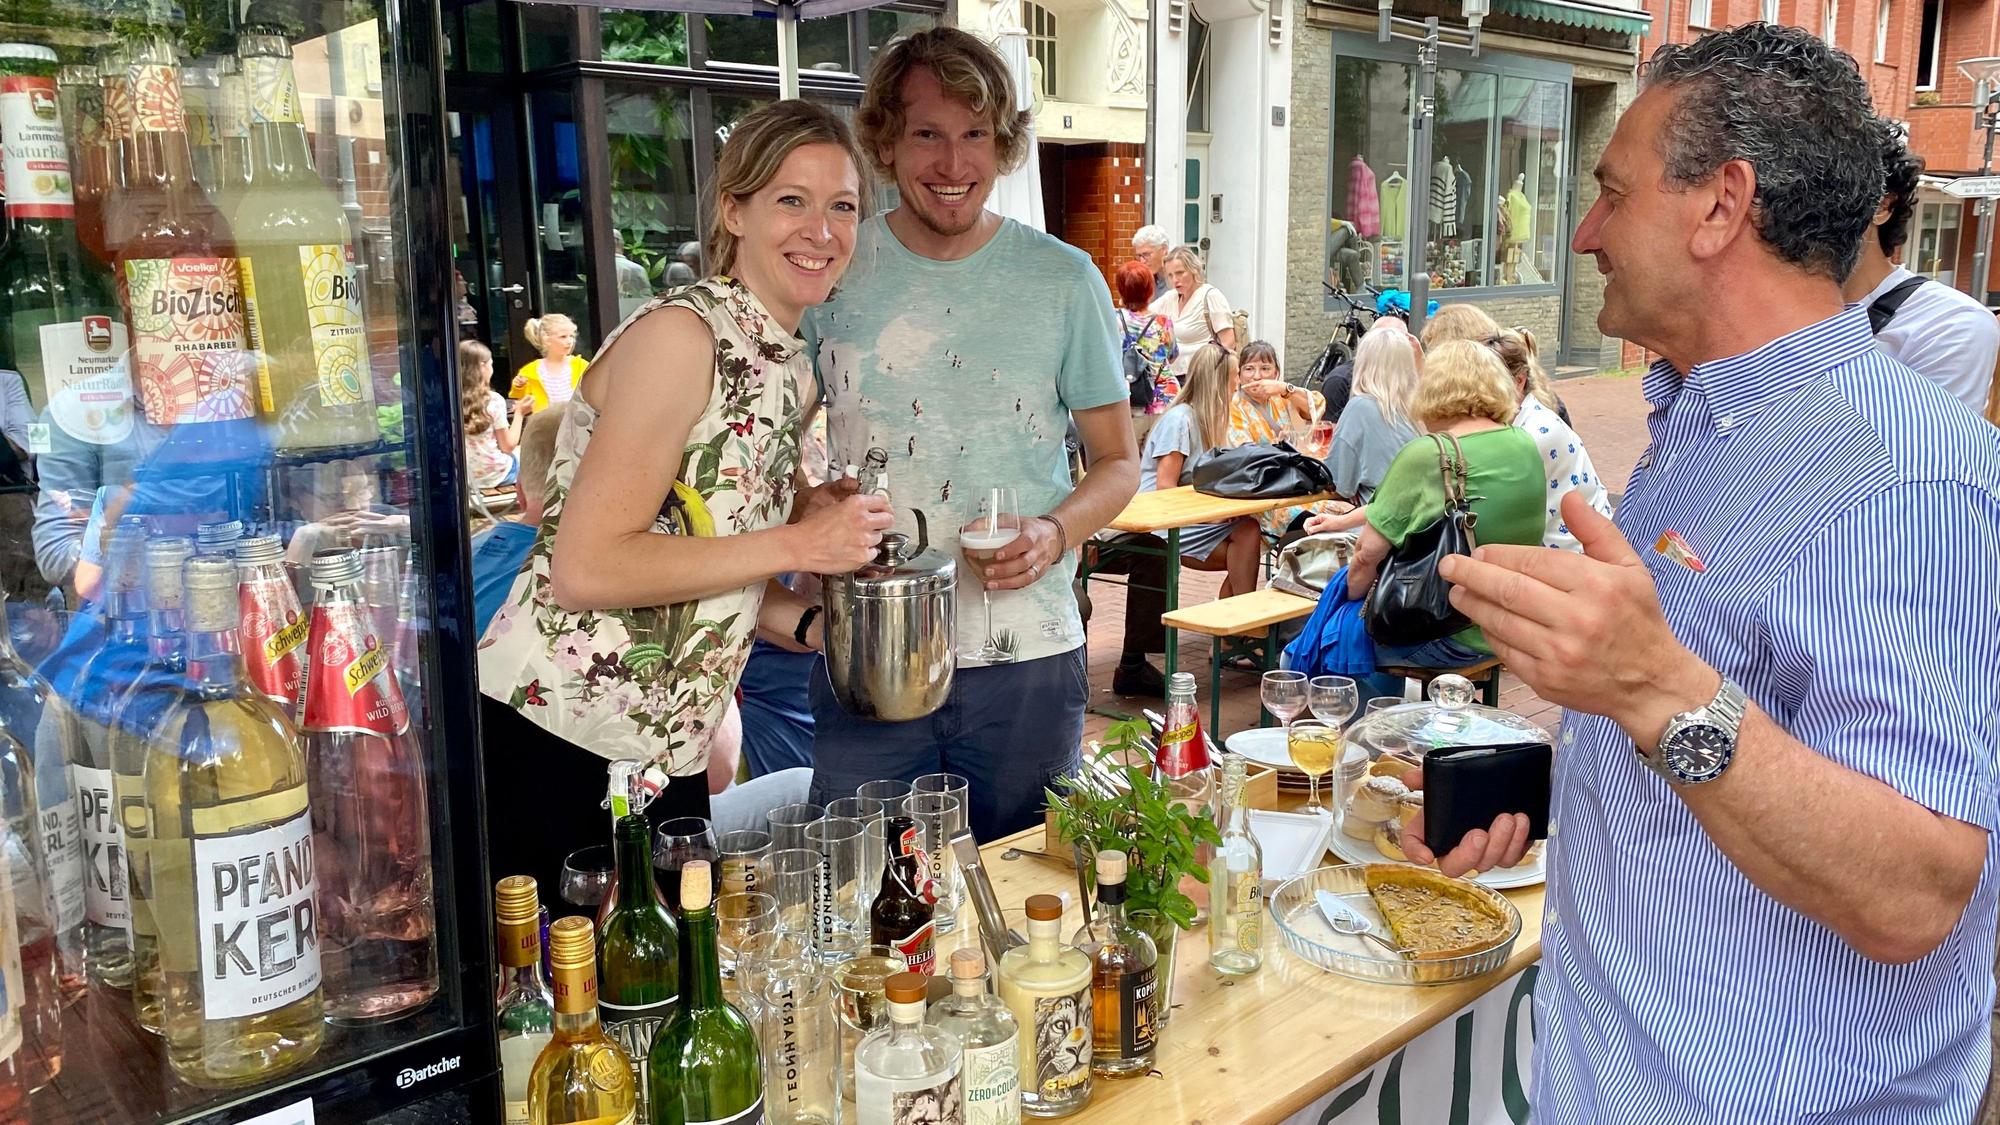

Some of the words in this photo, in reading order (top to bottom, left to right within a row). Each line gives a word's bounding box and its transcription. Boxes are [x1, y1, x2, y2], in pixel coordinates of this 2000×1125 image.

[1276, 111, 1284, 121] 10
[177, 262, 219, 273] Voelkel
[151, 287, 242, 321] BioZisch
[174, 341, 237, 352] RHABARBER
[366, 707, 389, 722] WILD
[932, 804, 942, 886] EONHARDT
[212, 834, 314, 911] PFAND
[213, 890, 321, 983] KER
[251, 984, 298, 1005] DEUTSCHER
[396, 1055, 462, 1090] Bartscher
[968, 1087, 992, 1102] ZÉRO
